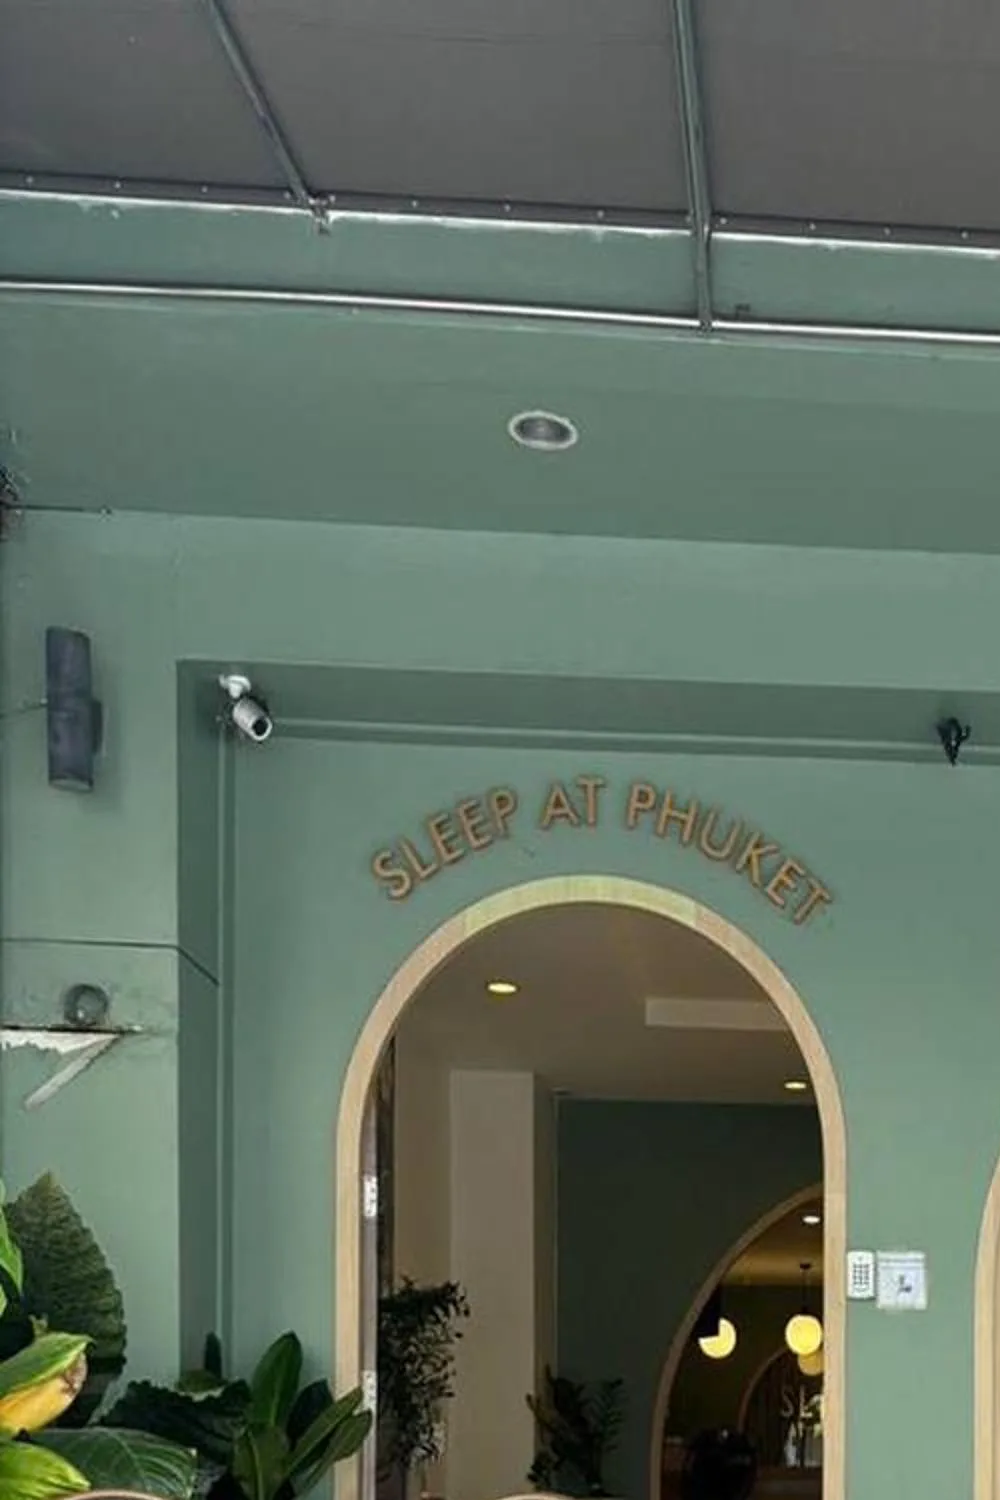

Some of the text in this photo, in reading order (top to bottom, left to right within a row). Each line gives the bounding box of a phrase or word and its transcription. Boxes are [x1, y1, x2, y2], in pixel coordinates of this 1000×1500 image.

[372, 775, 832, 926] SLEEP AT PHUKET
